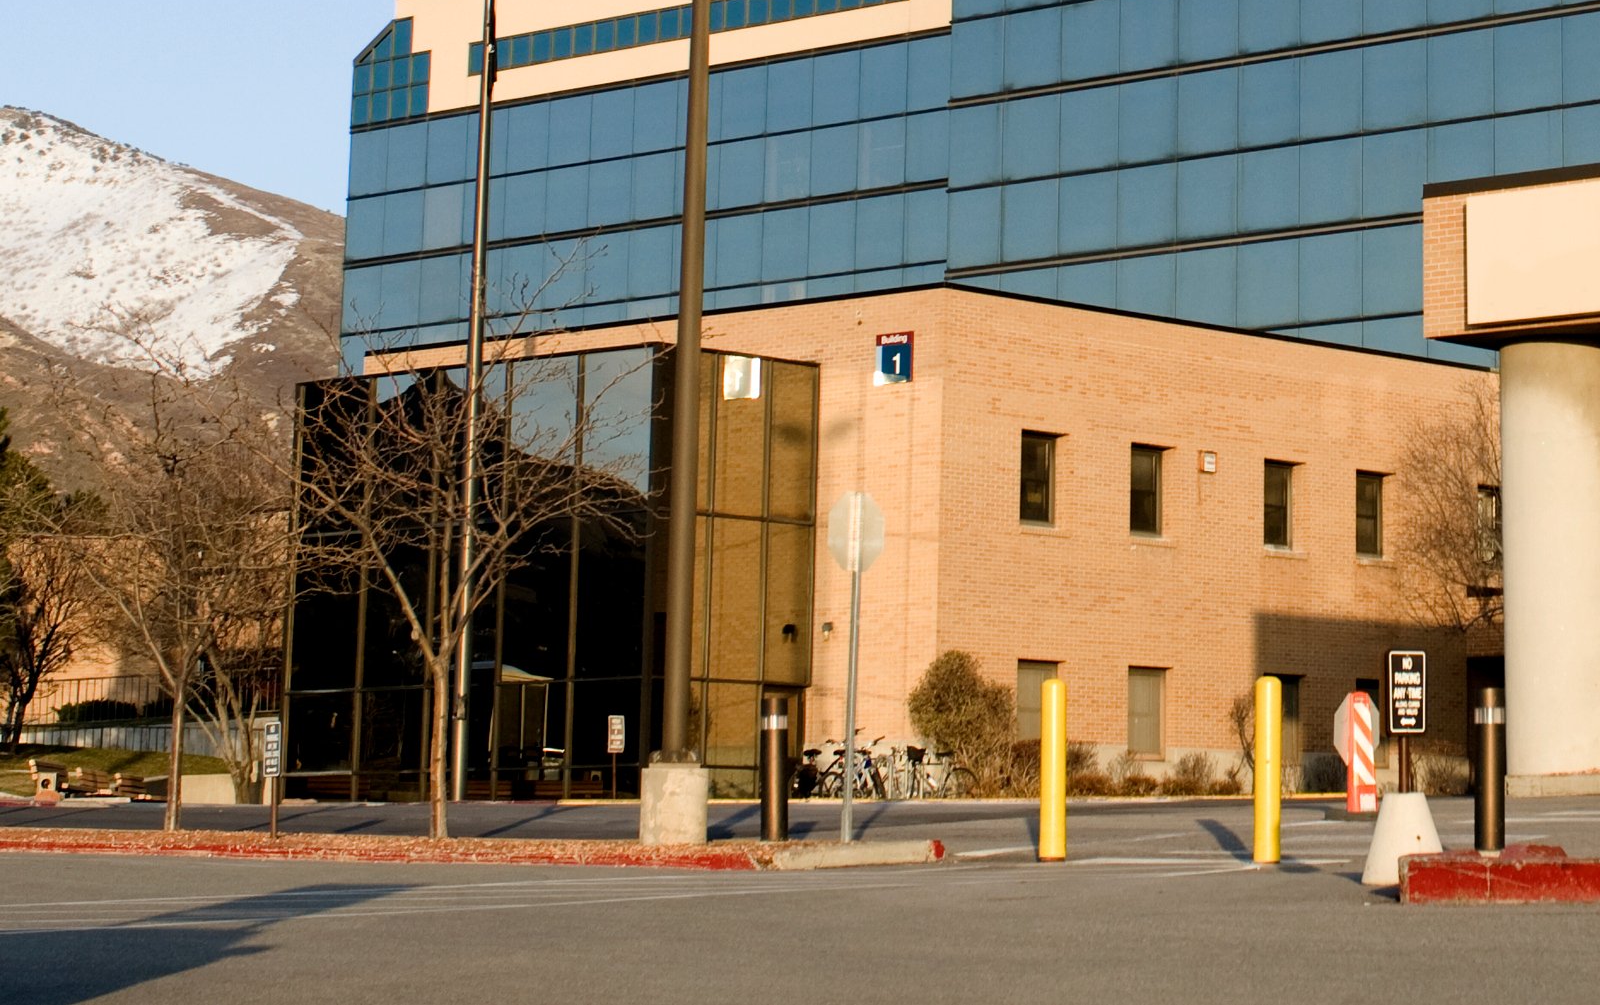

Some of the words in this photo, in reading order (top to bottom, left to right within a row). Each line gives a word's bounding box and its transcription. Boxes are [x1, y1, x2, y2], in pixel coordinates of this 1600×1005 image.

[892, 352, 900, 374] 1
[1402, 657, 1412, 669] NO
[1394, 672, 1420, 684] PARKING
[1393, 686, 1406, 700] ANY
[1407, 686, 1422, 700] TIME
